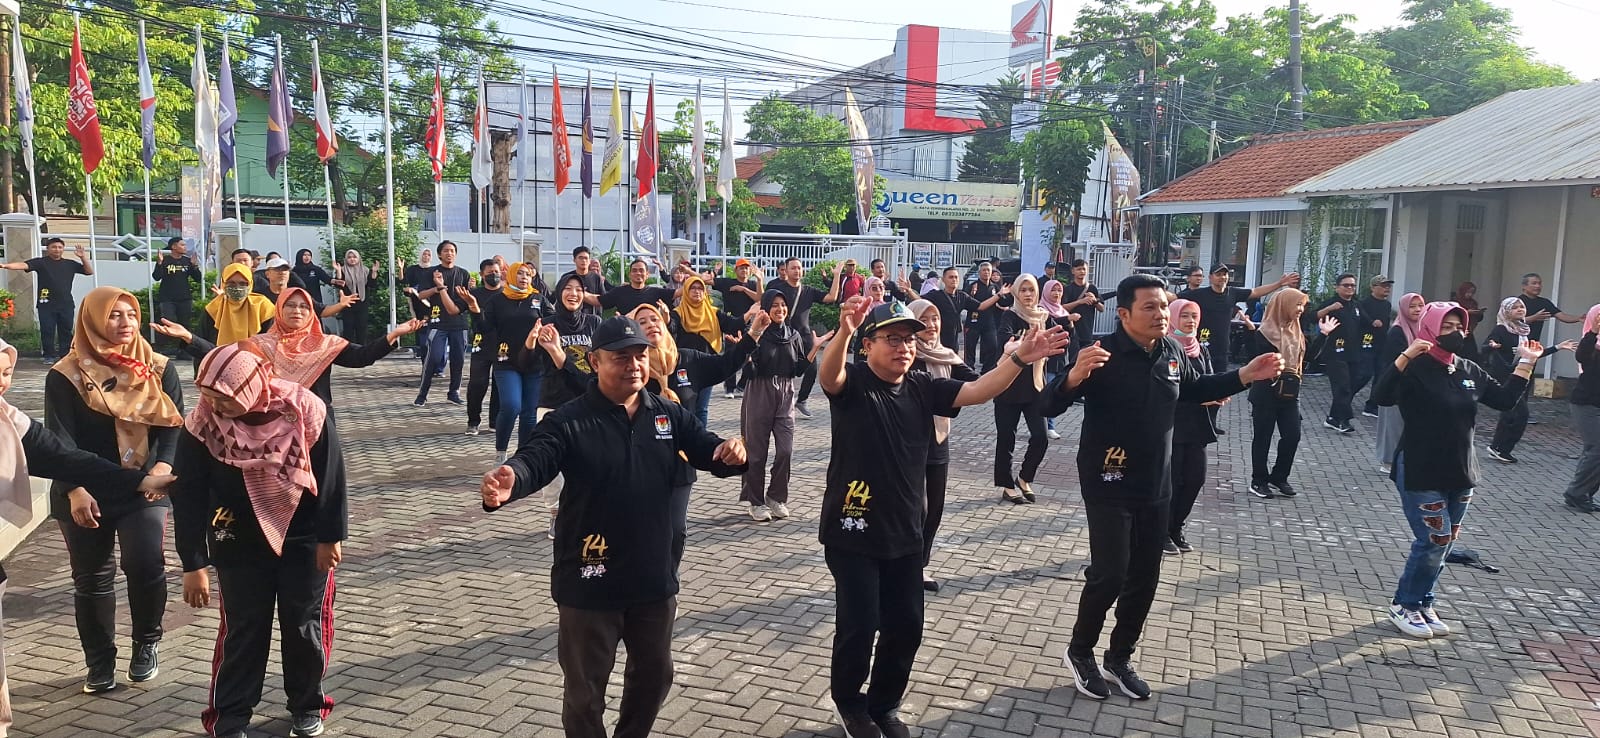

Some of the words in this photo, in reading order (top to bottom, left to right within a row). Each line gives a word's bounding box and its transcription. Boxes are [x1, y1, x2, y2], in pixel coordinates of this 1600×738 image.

[1011, 35, 1039, 48] HONDA
[876, 191, 958, 214] Queen
[1104, 446, 1128, 465] 14
[845, 480, 873, 506] 14
[212, 506, 235, 528] 14
[582, 534, 609, 557] 14
